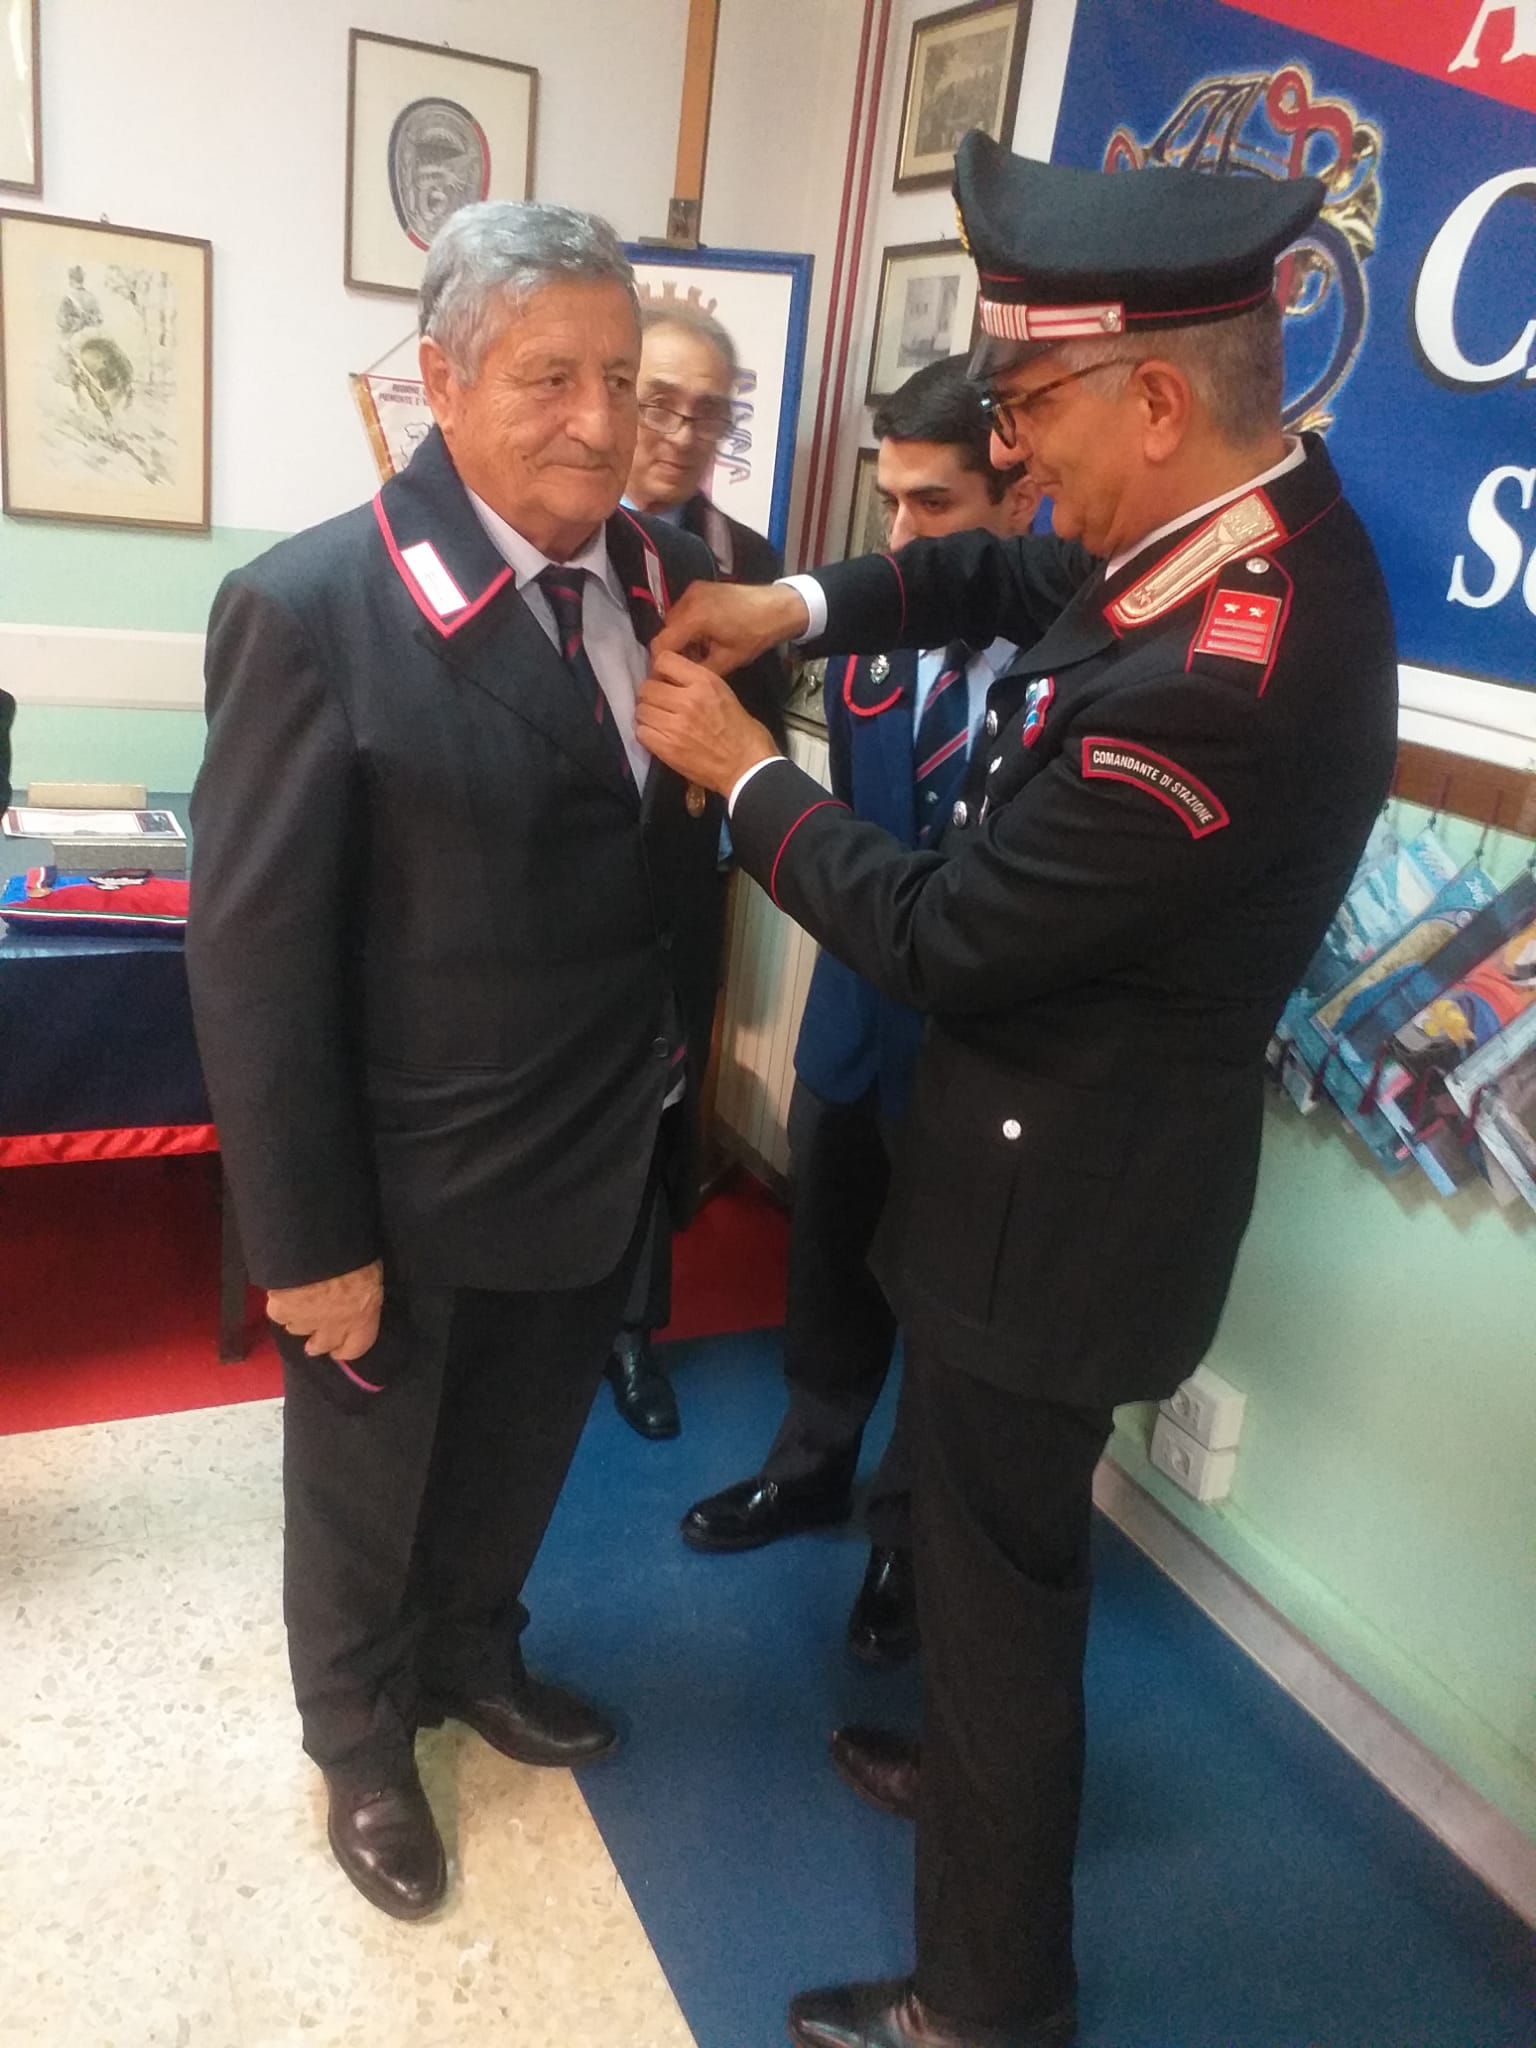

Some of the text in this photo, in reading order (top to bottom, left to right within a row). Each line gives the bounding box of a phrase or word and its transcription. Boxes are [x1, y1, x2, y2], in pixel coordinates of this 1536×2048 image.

[1447, 0, 1536, 73] A
[1415, 167, 1536, 382] C
[1446, 465, 1536, 616] S
[1093, 750, 1215, 825] COMANDANTE DI STAZIONE
